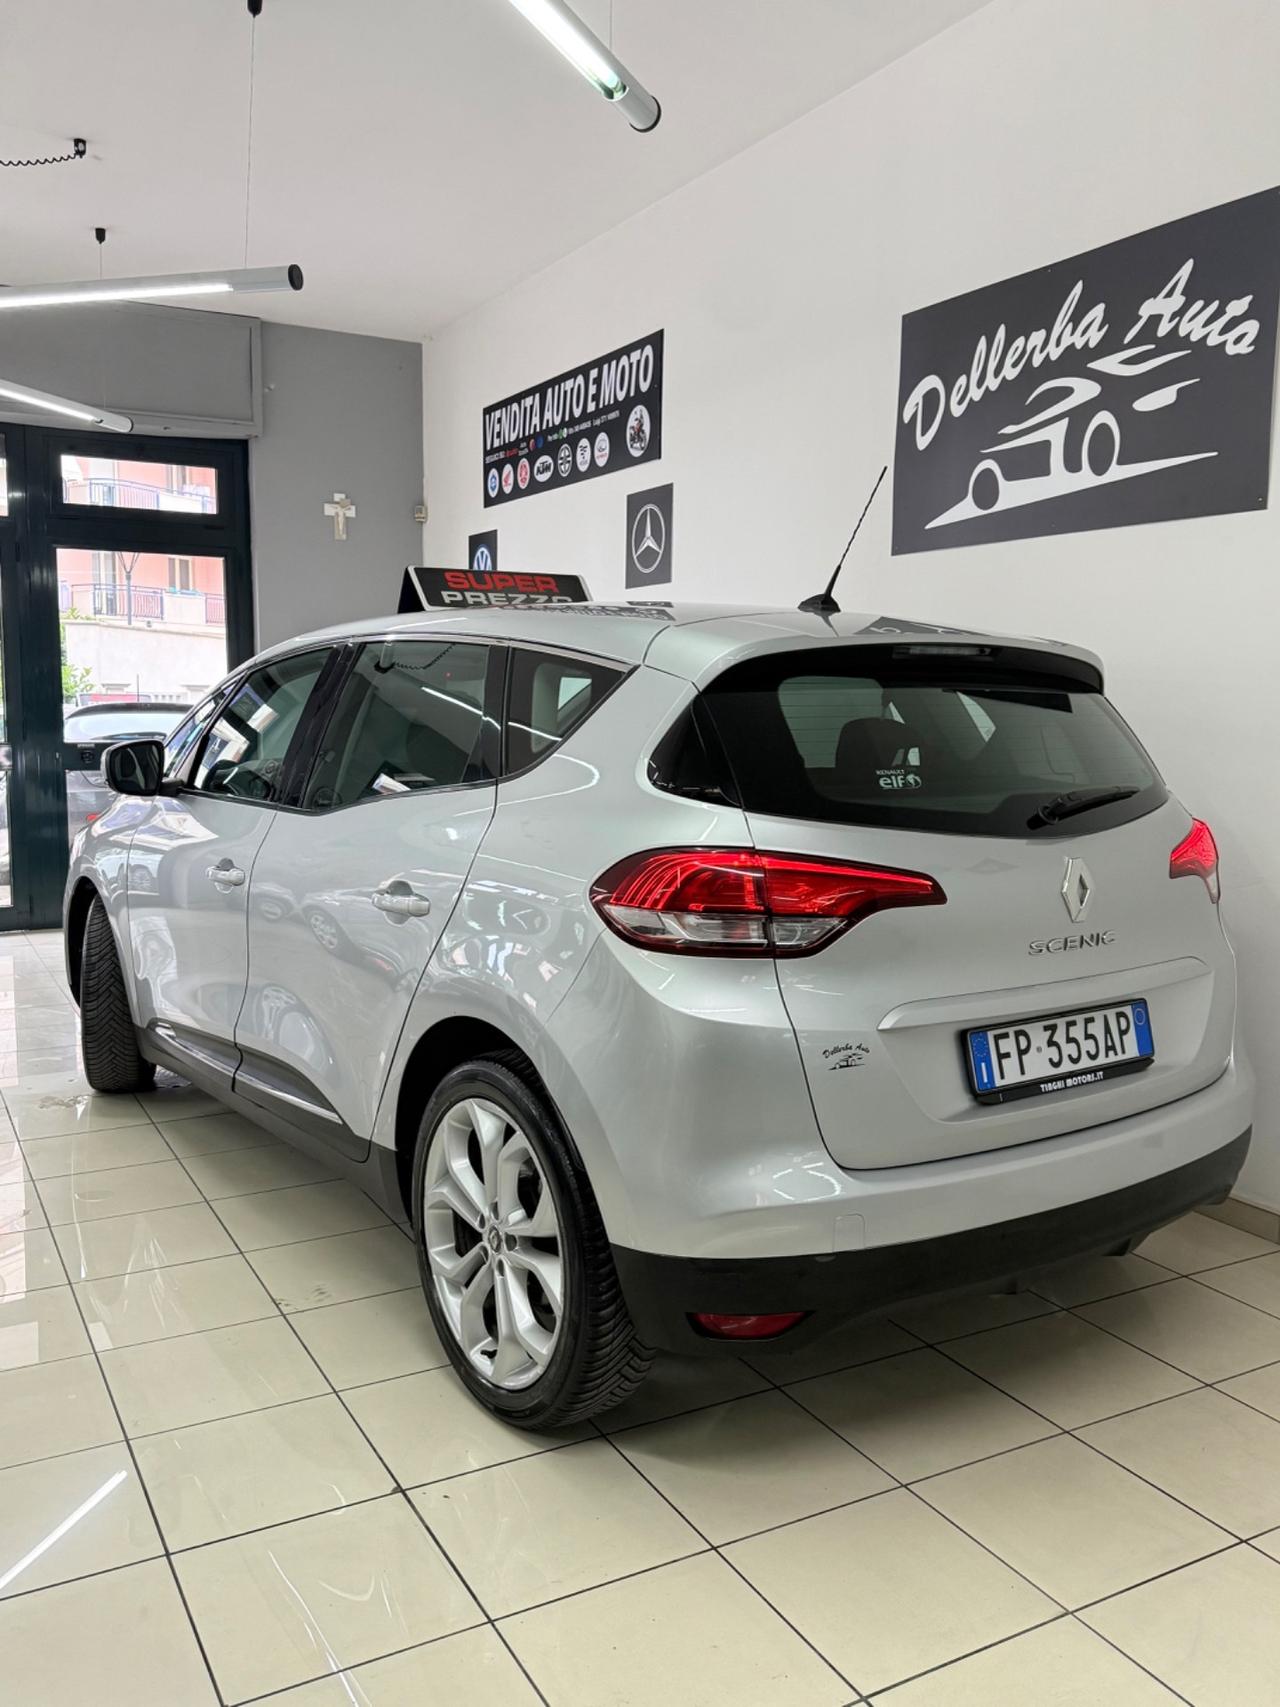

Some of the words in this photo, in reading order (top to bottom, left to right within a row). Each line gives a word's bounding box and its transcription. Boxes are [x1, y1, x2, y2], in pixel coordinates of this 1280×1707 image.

[902, 279, 1109, 451] Dellerba
[1122, 257, 1261, 356] Auto
[485, 392, 540, 451] VENDITA
[542, 373, 585, 430] AUTO
[587, 367, 598, 414] E
[599, 344, 654, 409] MOTO
[536, 460, 552, 477] KTM
[444, 571, 560, 593] SUPER
[879, 775, 906, 789] elf
[1028, 929, 1117, 956] SCENIC
